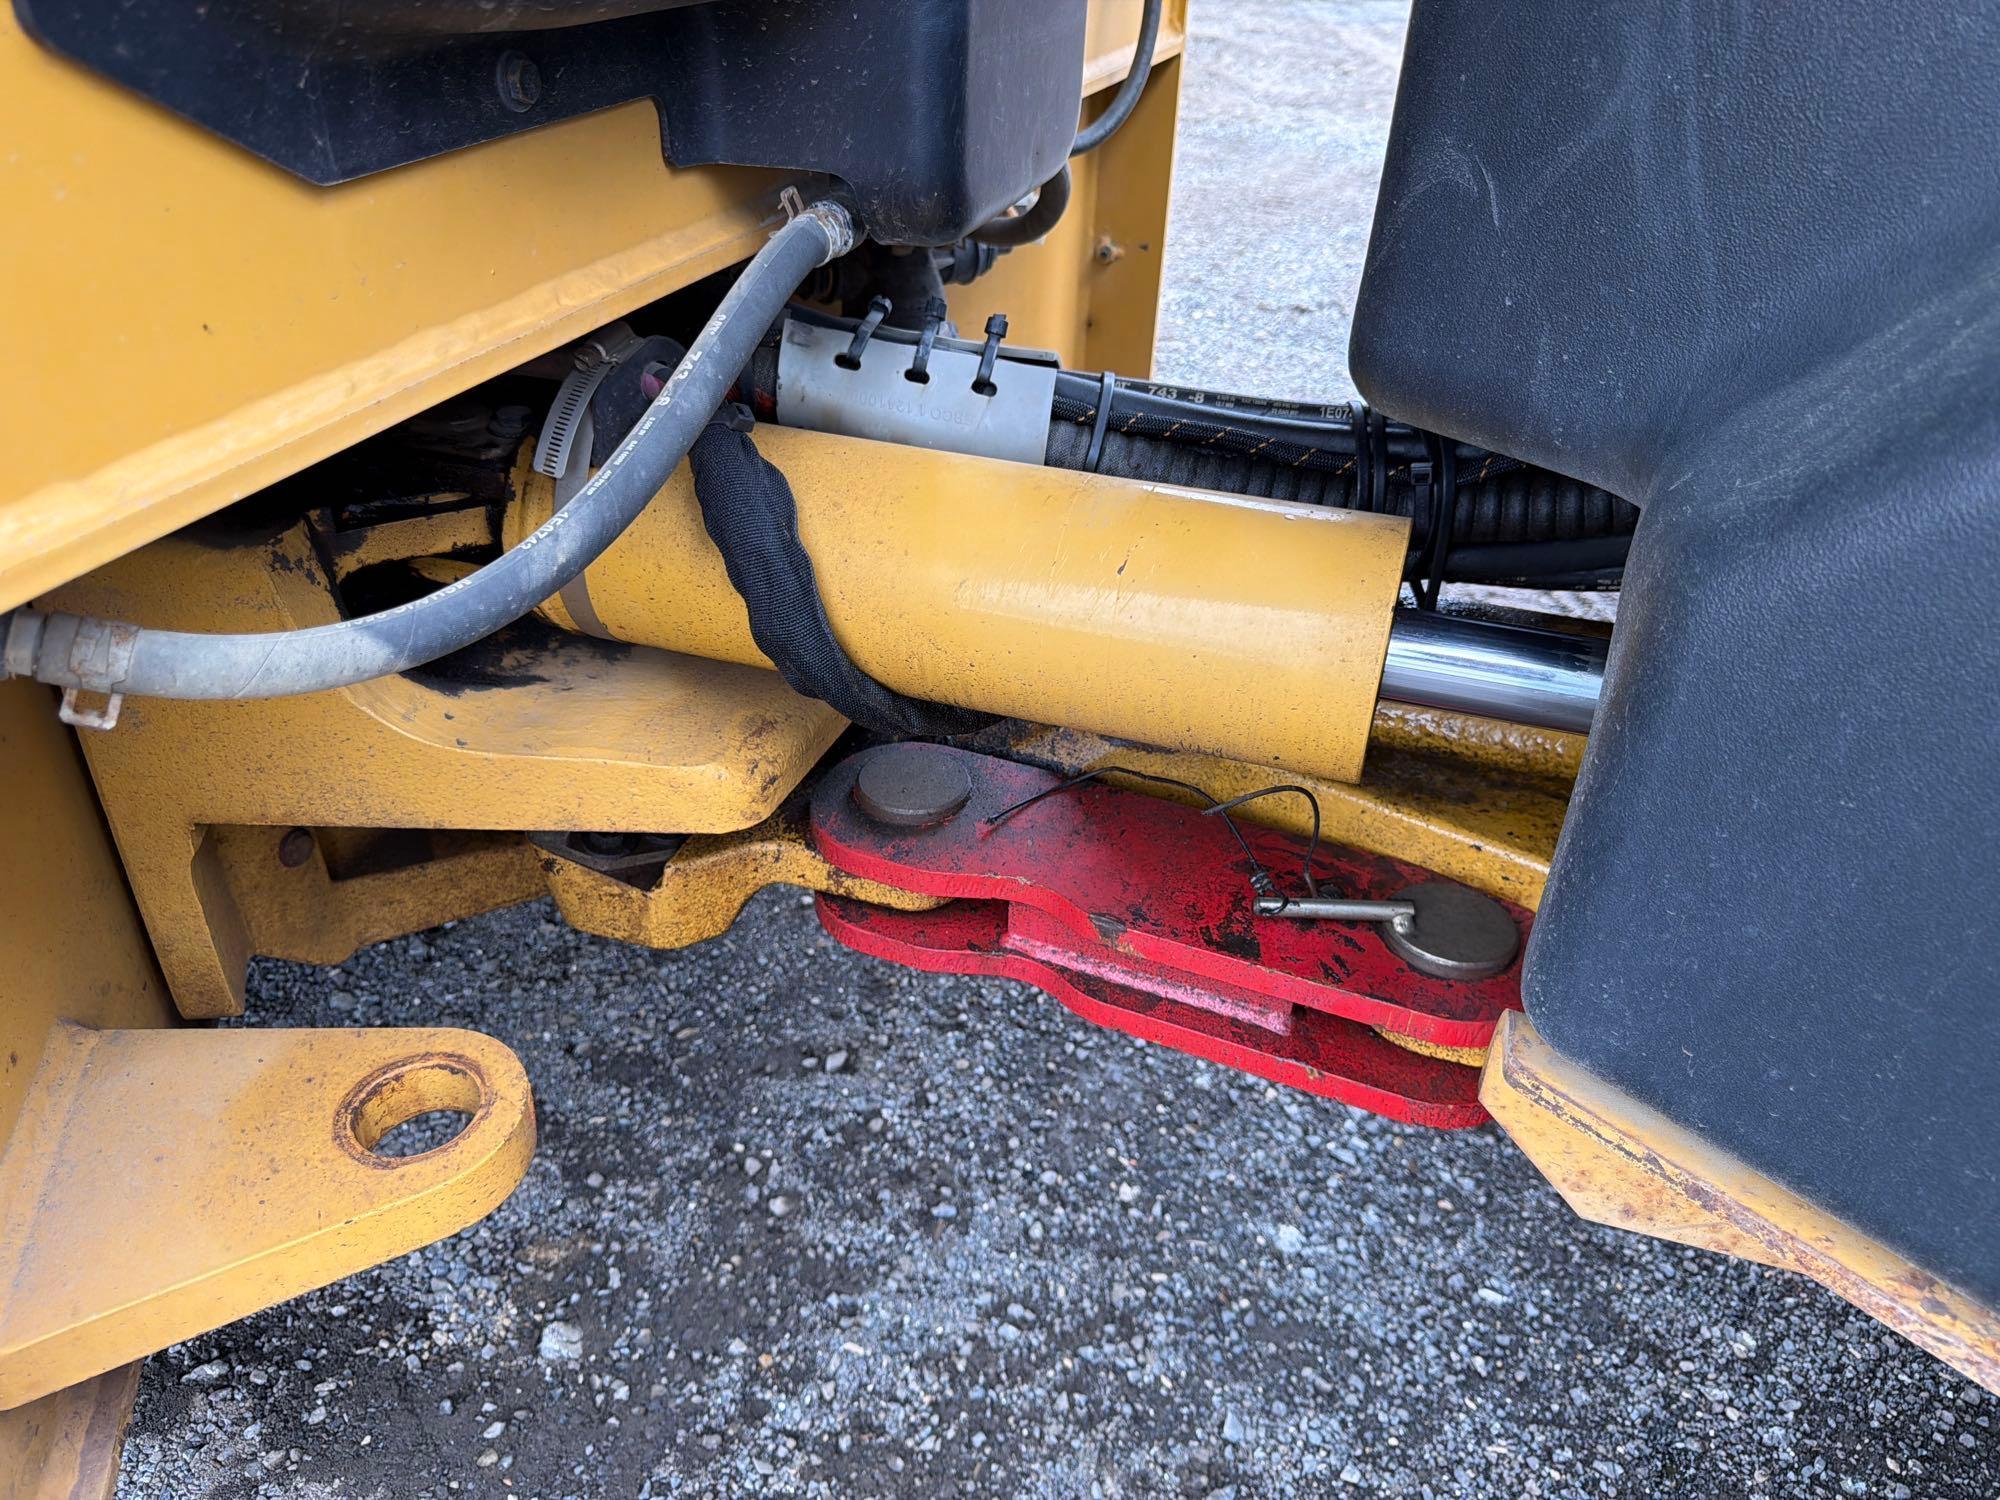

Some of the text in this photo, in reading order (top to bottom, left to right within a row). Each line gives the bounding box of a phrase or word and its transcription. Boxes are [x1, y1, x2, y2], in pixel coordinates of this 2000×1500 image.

[1147, 385, 1178, 400] 743
[1188, 391, 1205, 404] -8
[1319, 406, 1352, 419] 1E07
